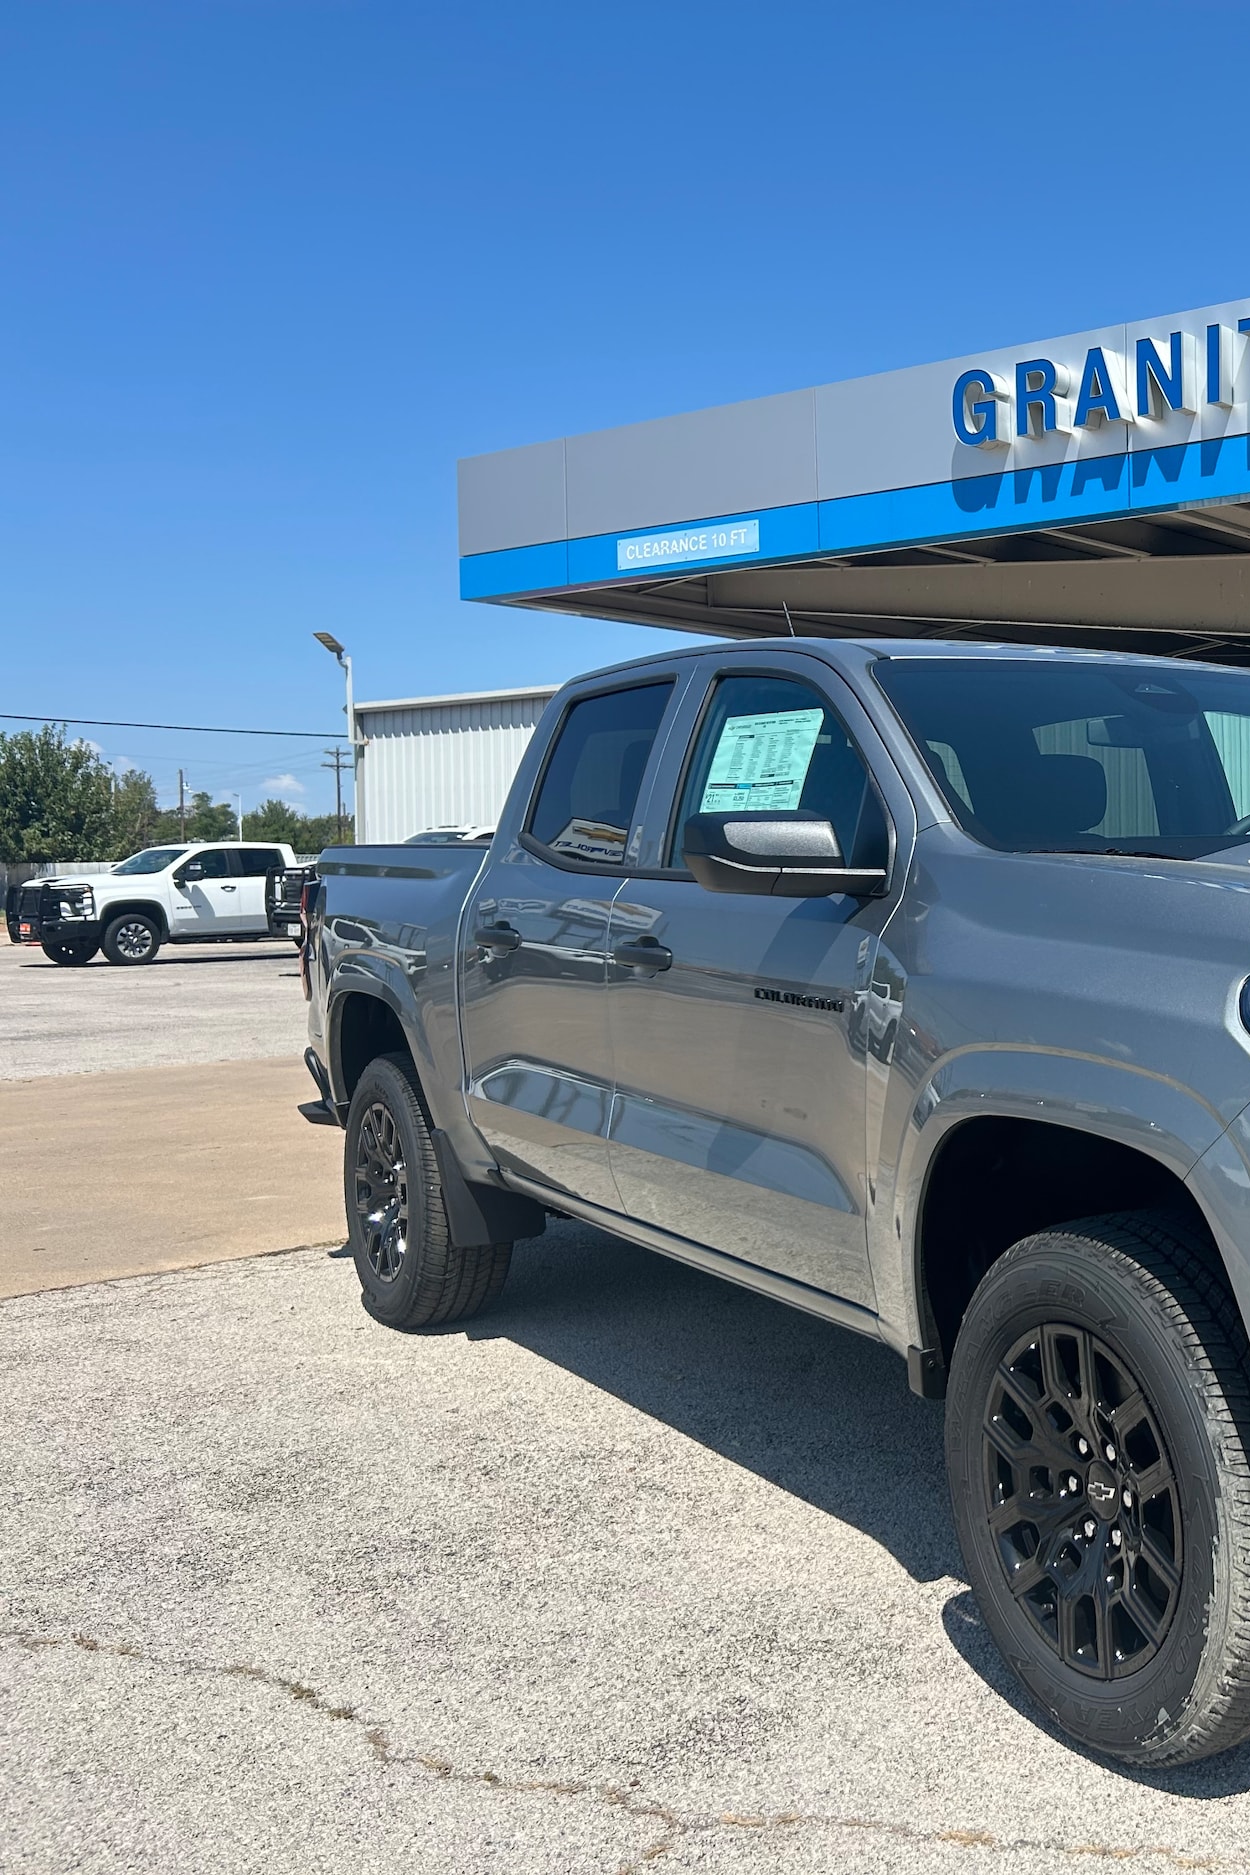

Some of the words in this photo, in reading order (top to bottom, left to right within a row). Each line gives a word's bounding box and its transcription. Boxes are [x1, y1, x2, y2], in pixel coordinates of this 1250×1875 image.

[626, 534, 707, 560] CLEARANCE
[711, 533, 727, 548] 10
[730, 528, 748, 546] FT
[754, 987, 844, 1013] COLORADO
